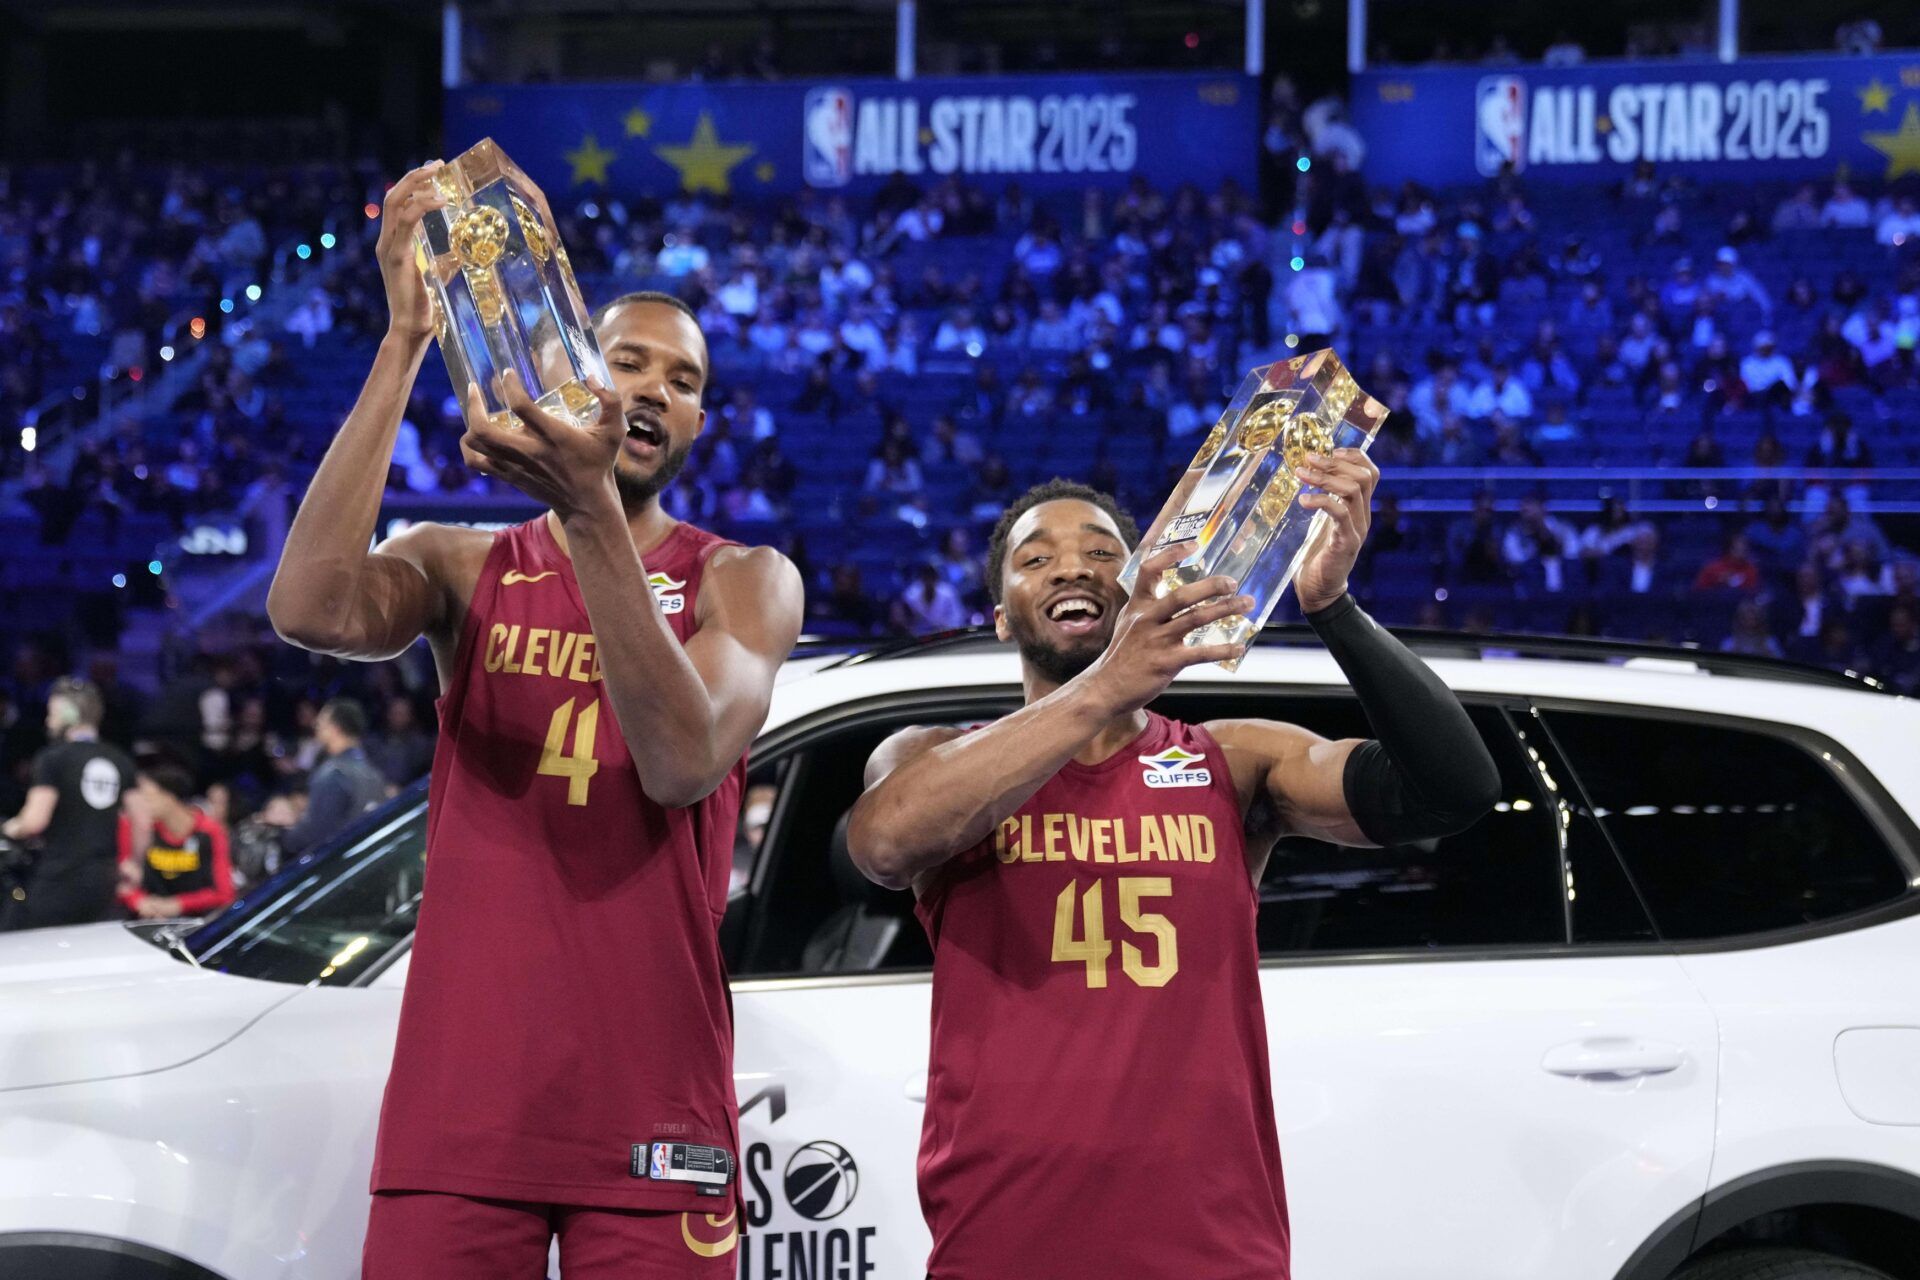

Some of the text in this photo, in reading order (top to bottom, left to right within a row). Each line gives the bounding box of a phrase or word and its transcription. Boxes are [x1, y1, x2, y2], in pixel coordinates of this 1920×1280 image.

[855, 92, 1137, 174] ALL STAR 2025
[1528, 79, 1830, 164] ALL STAR 2025
[536, 696, 600, 806] 4
[1146, 771, 1209, 784] CLIFFS
[995, 813, 1216, 864] CLEVELAND
[1051, 877, 1179, 988] 45
